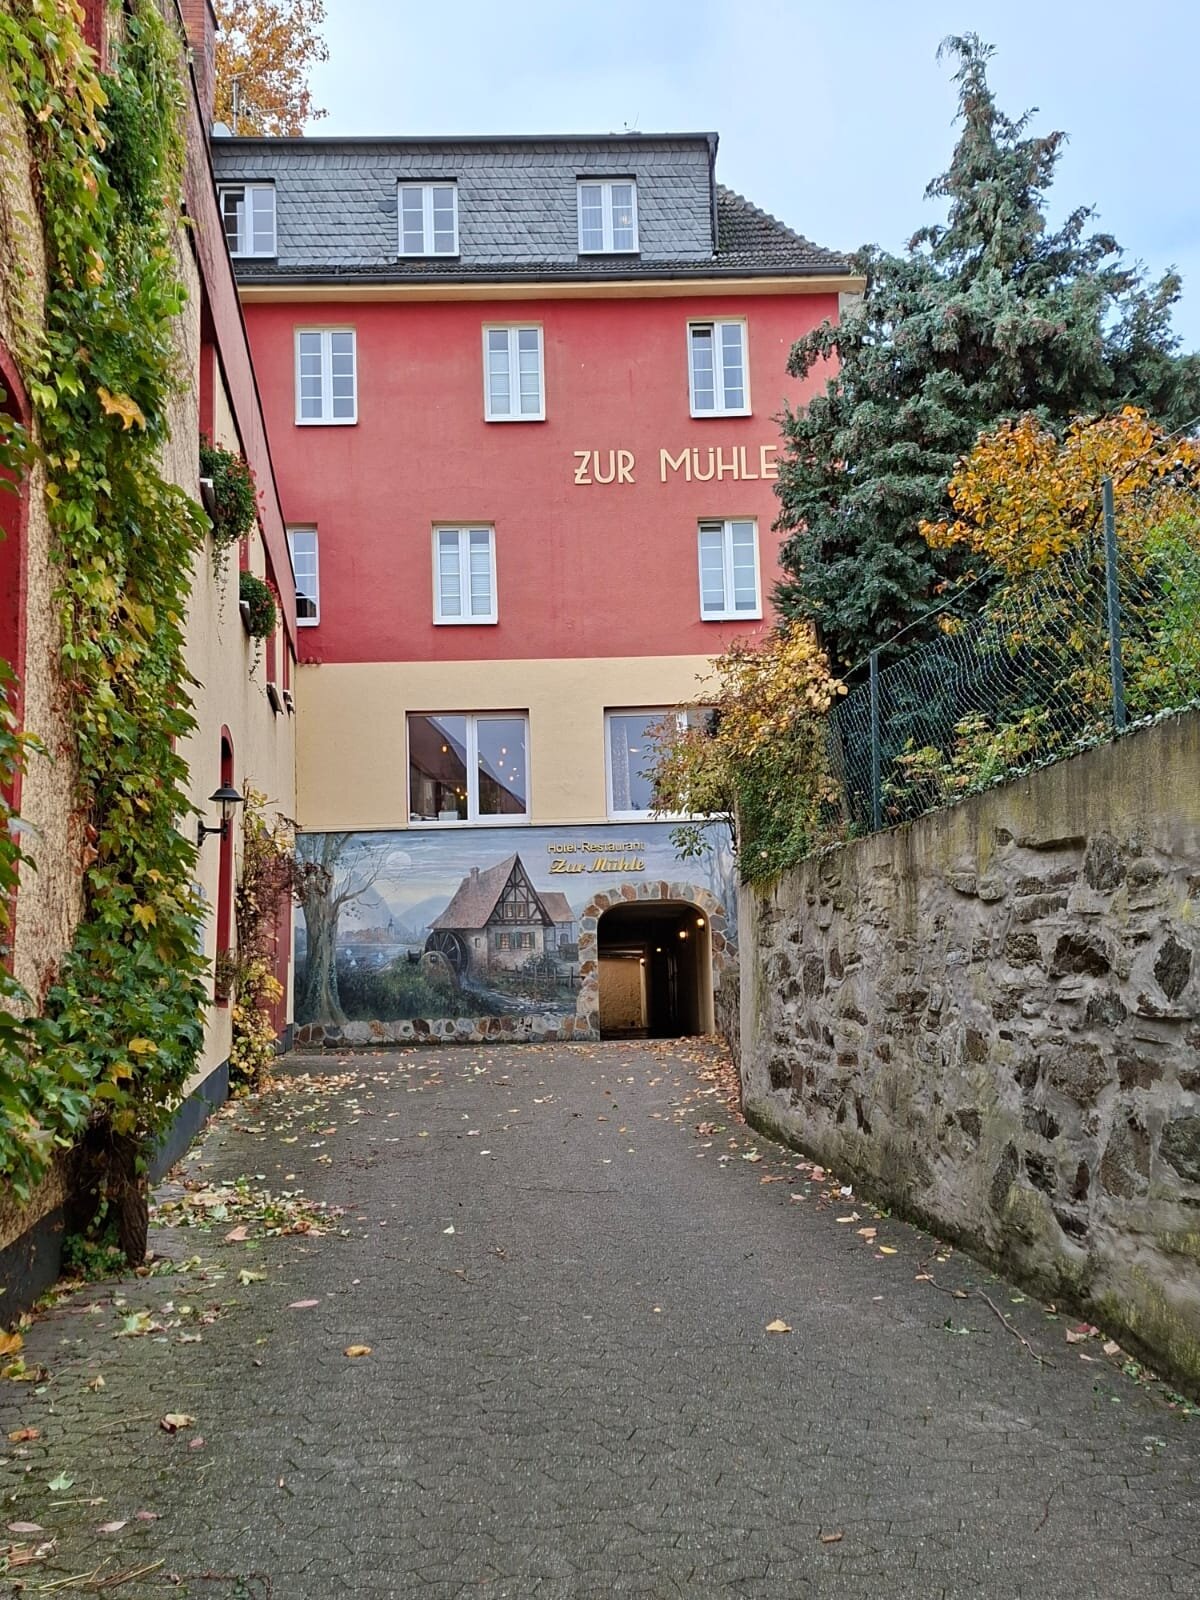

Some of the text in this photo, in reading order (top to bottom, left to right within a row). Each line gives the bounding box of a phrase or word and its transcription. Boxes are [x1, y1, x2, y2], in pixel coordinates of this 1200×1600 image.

[574, 445, 779, 485] ZUR MÜHLE
[547, 841, 645, 854] Hotel-Restaurant
[548, 856, 645, 874] Zur Mühle
